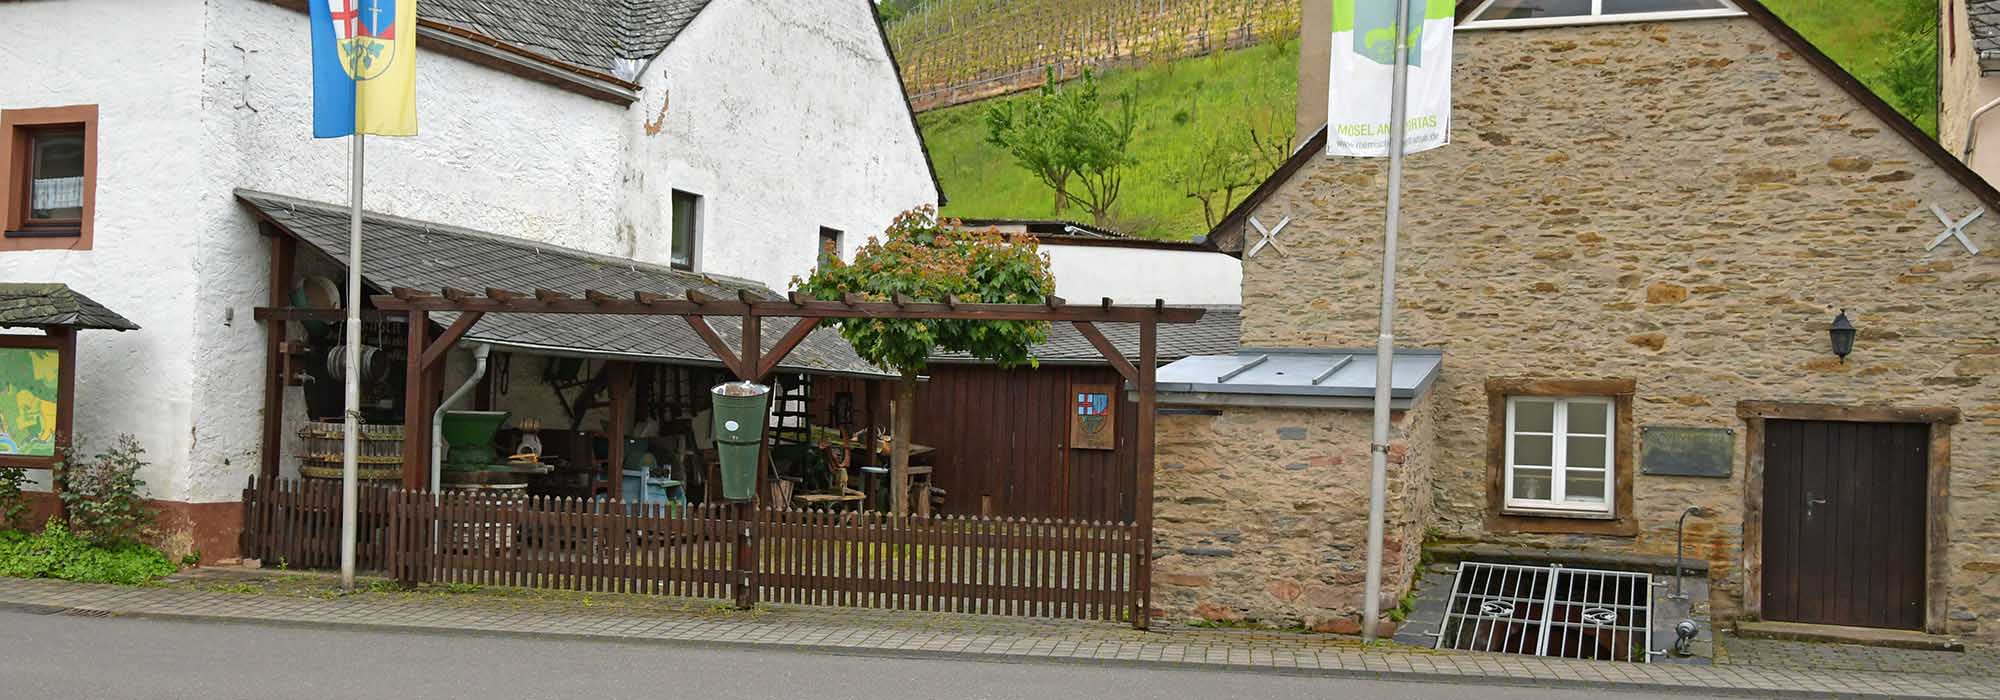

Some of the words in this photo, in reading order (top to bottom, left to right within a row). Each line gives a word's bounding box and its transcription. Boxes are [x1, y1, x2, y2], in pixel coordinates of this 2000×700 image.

[1337, 123, 1375, 136] MOSEL
[1377, 122, 1391, 135] AN
[1407, 115, 1437, 131] ORTAS
